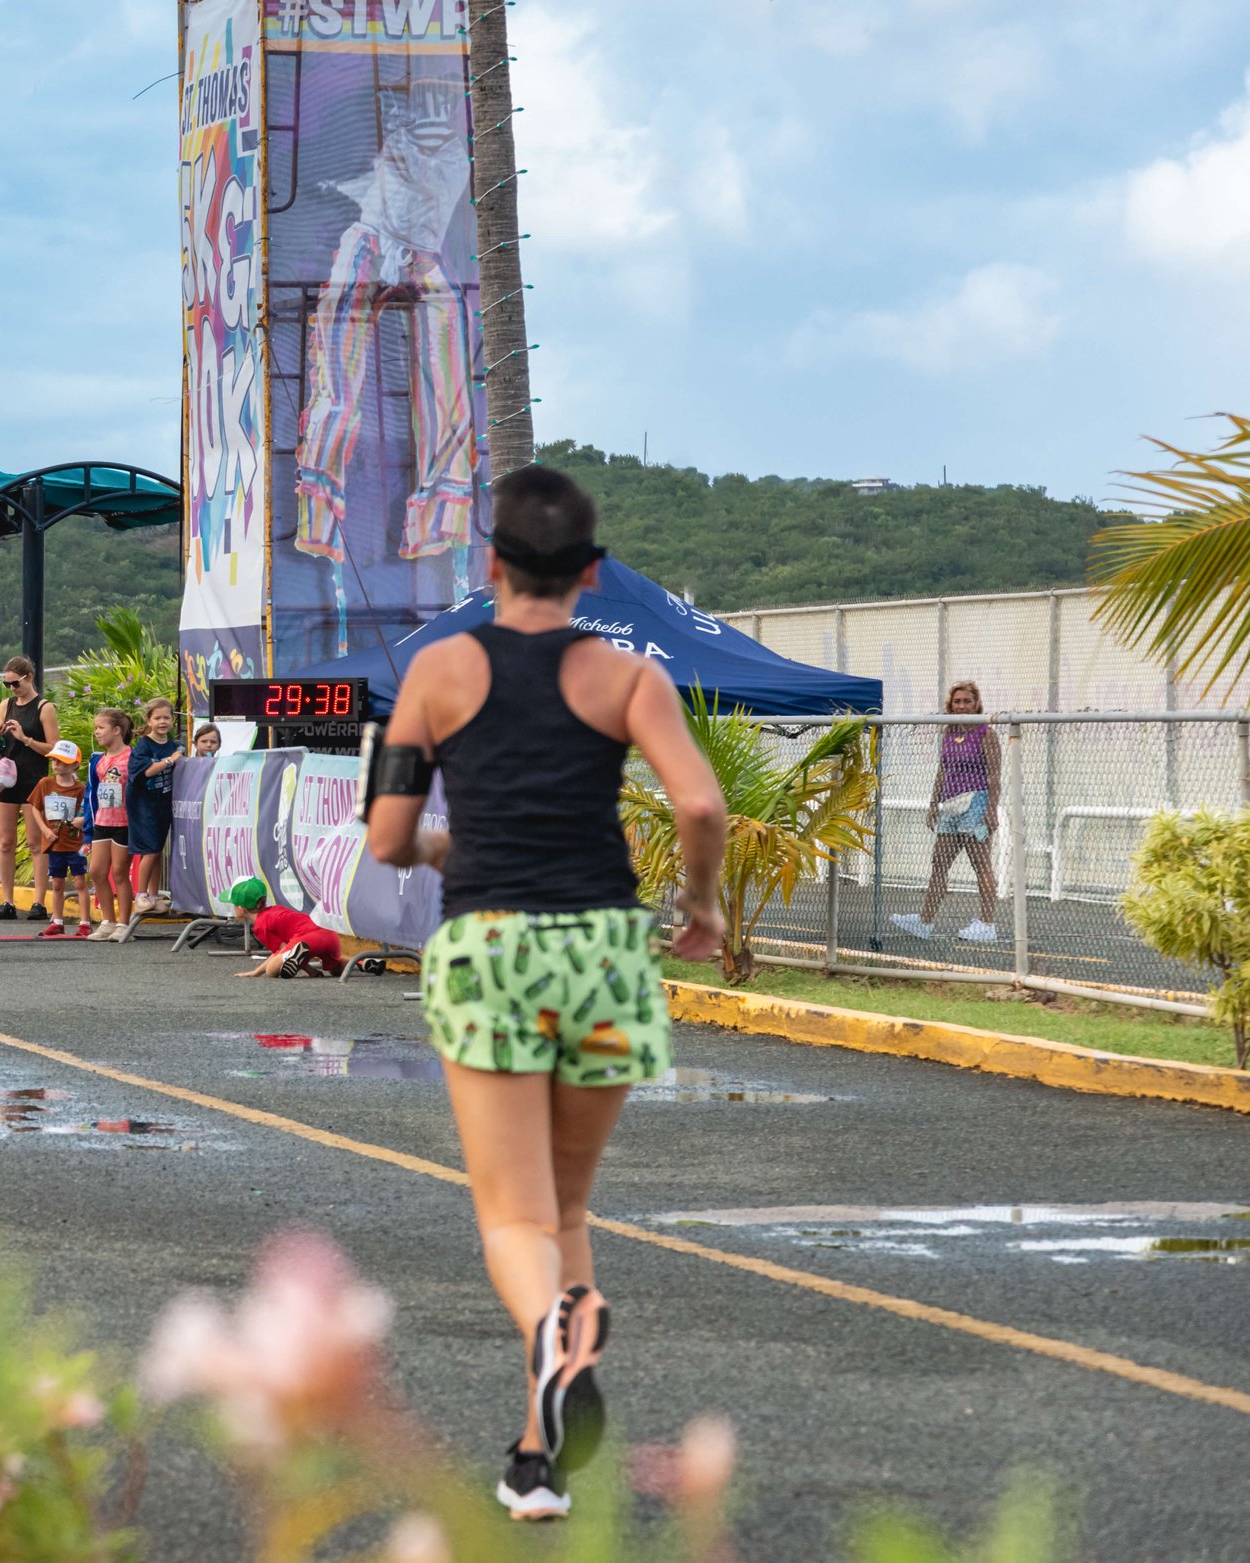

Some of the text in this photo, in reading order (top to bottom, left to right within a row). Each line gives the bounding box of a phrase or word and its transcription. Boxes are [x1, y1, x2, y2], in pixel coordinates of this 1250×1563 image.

[182, 60, 250, 136] ST. THOMAS
[568, 616, 635, 636] Michelob
[53, 801, 67, 812] 39
